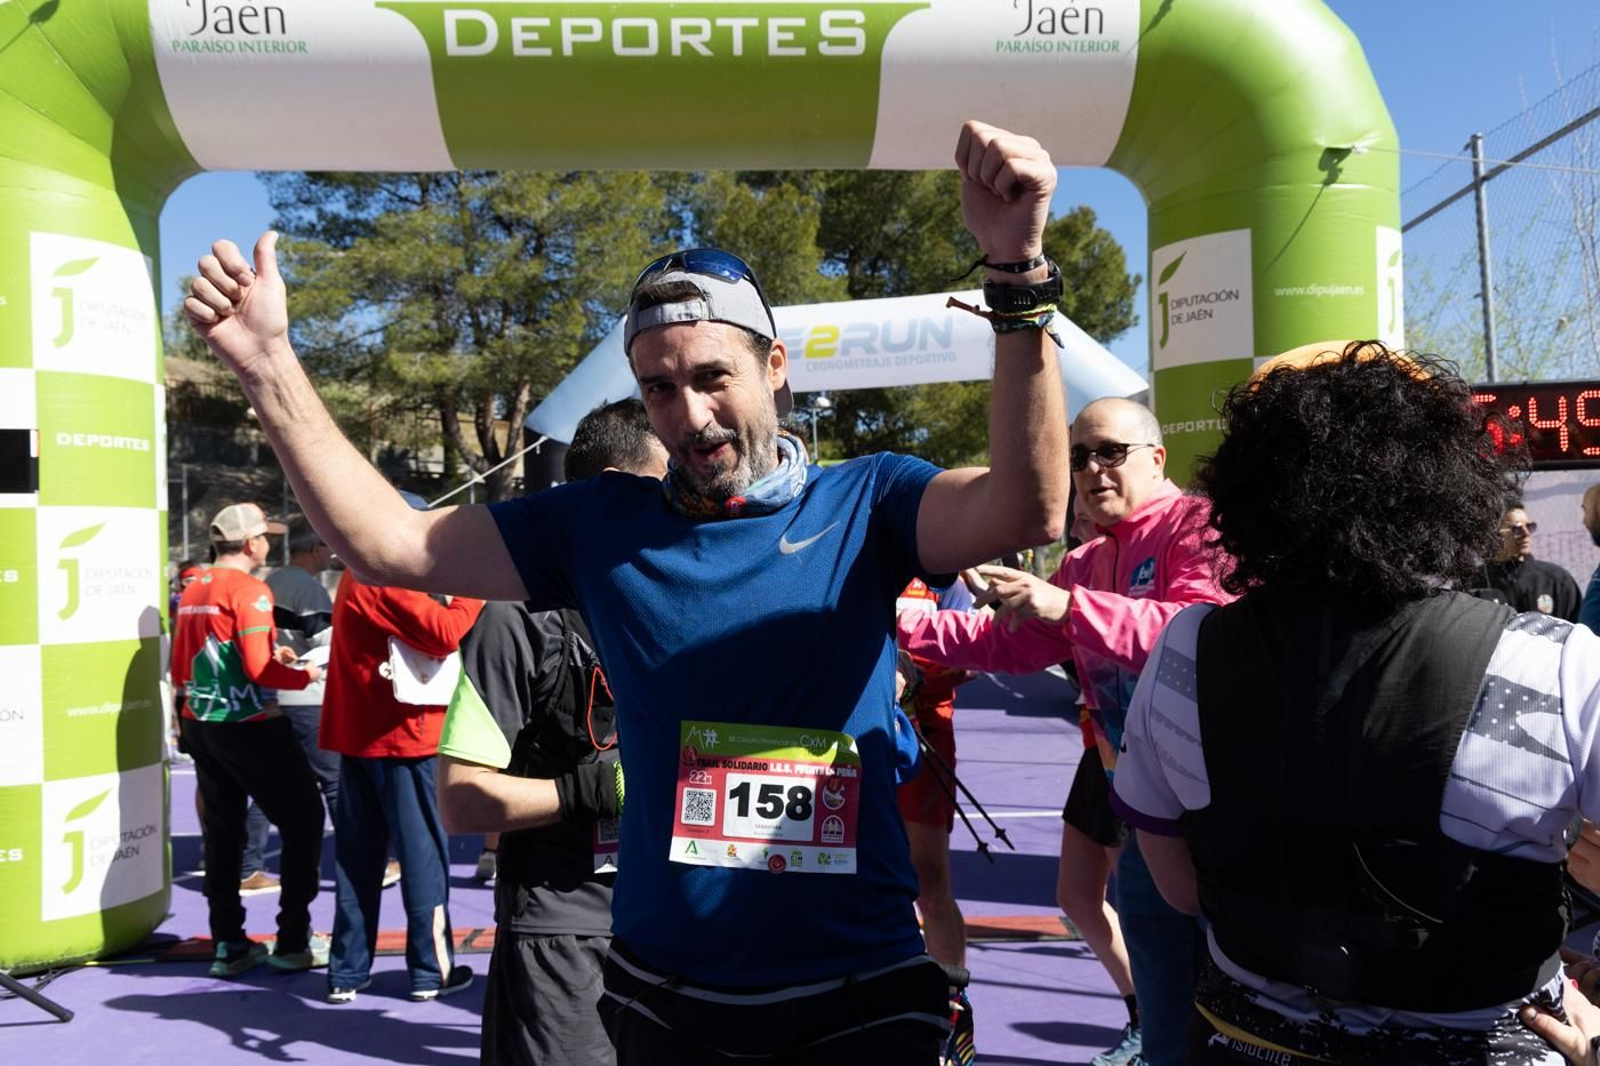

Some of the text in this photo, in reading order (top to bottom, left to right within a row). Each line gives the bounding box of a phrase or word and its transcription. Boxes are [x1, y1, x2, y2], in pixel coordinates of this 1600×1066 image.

[443, 9, 867, 57] DEPORTES
[238, 40, 308, 54] INTERIOR
[995, 38, 1120, 53] PARAÍSO INTERIOR
[1273, 282, 1365, 298] www.dipujaen.es
[1170, 289, 1240, 311] DIPUTACIÓN
[1171, 313, 1185, 326] DE
[805, 352, 958, 373] CRONOMETRAJE DEPORTIVO
[55, 432, 150, 452] DEPORTES
[800, 735, 827, 748] CxM
[721, 760, 768, 771] SOLIDARIO
[729, 782, 813, 821] 158
